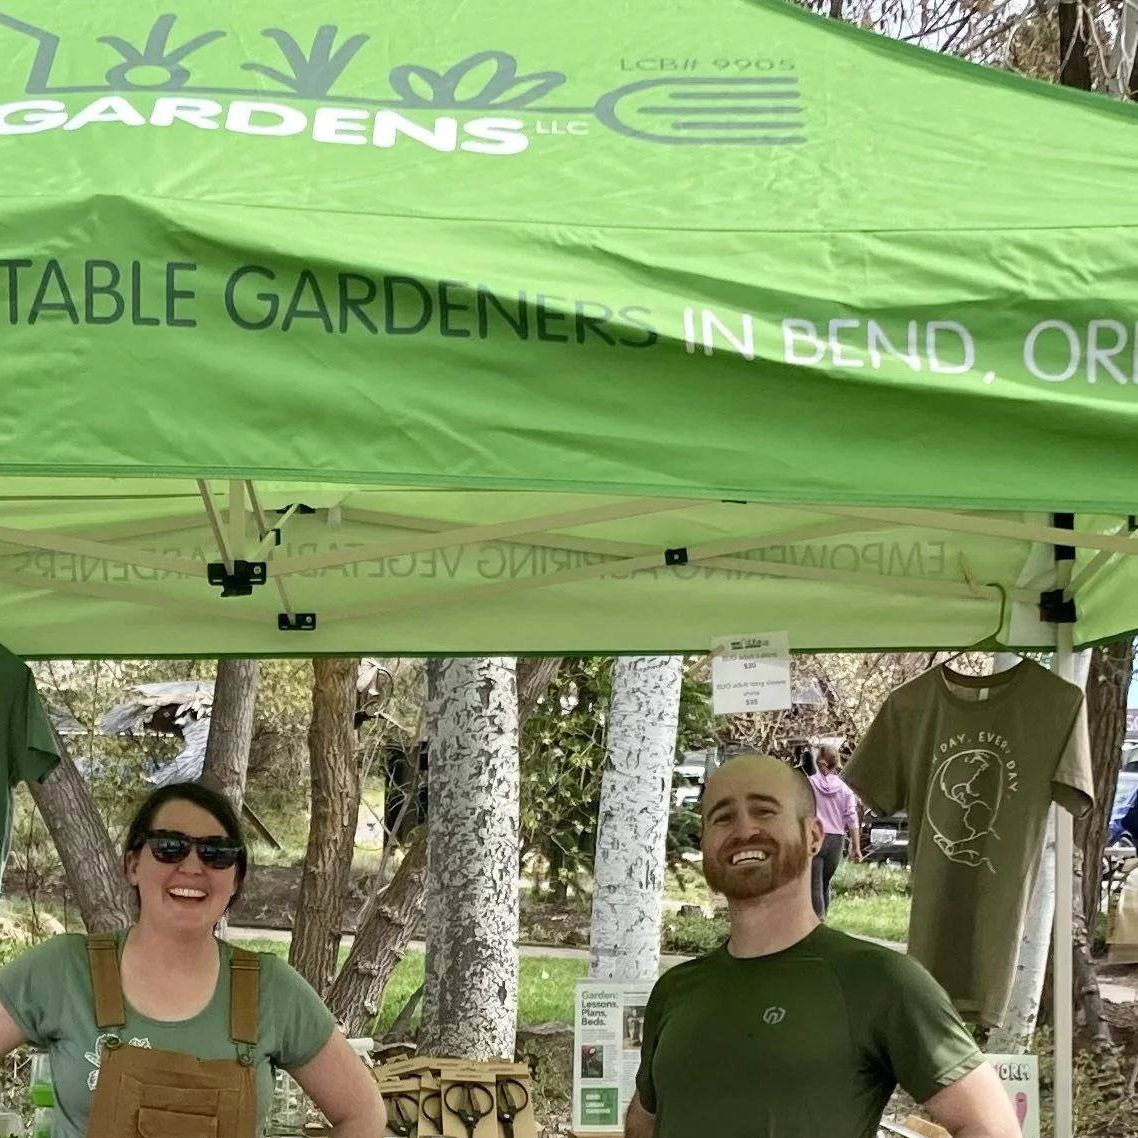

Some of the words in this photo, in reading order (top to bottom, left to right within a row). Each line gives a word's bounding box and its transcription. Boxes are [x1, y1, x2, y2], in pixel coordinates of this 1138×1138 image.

[620, 57, 701, 73] LCB#
[712, 57, 796, 73] 9905
[536, 119, 590, 136] LLC
[225, 264, 659, 348] GARDENERS
[683, 307, 755, 361] IN
[782, 318, 996, 384] BEND,
[1023, 319, 1138, 385] OR
[581, 990, 619, 999] Garden:
[994, 1062, 1030, 1081] ORM
